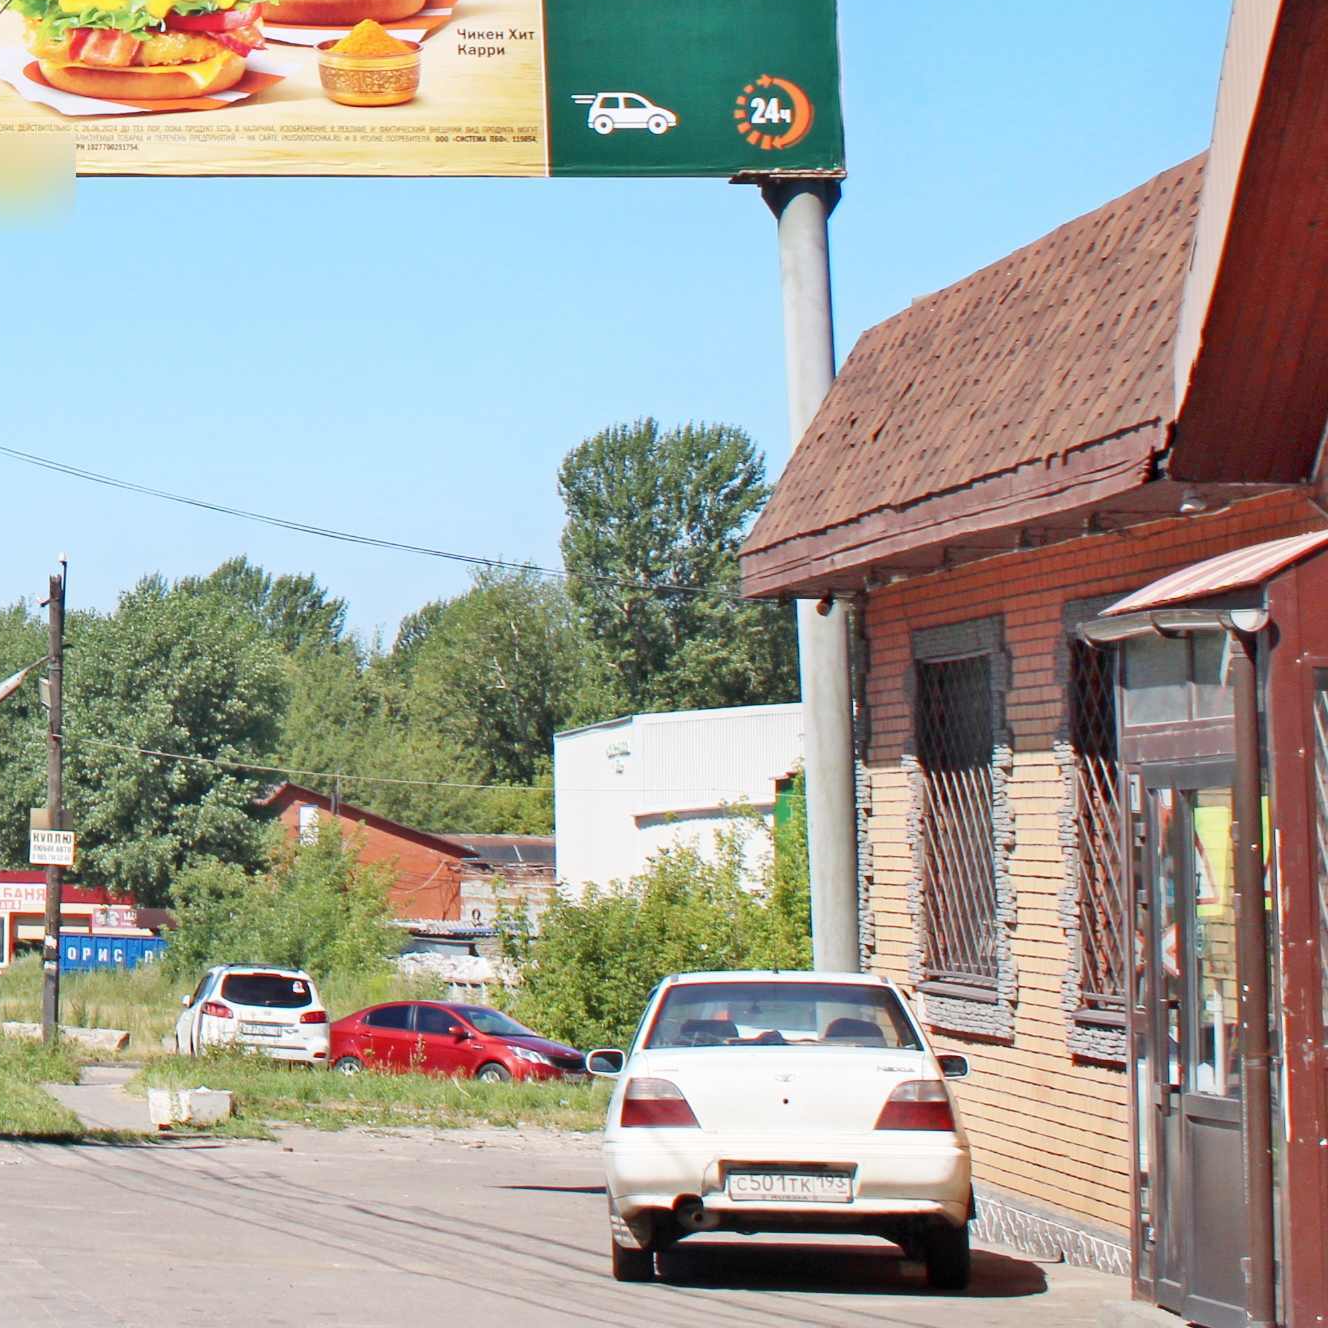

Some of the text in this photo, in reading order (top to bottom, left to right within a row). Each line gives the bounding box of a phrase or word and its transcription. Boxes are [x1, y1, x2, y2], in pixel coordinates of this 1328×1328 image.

[457, 28, 535, 40] Чикен Хит
[457, 44, 505, 58] Карри
[33, 832, 72, 844] КУПЛЮ
